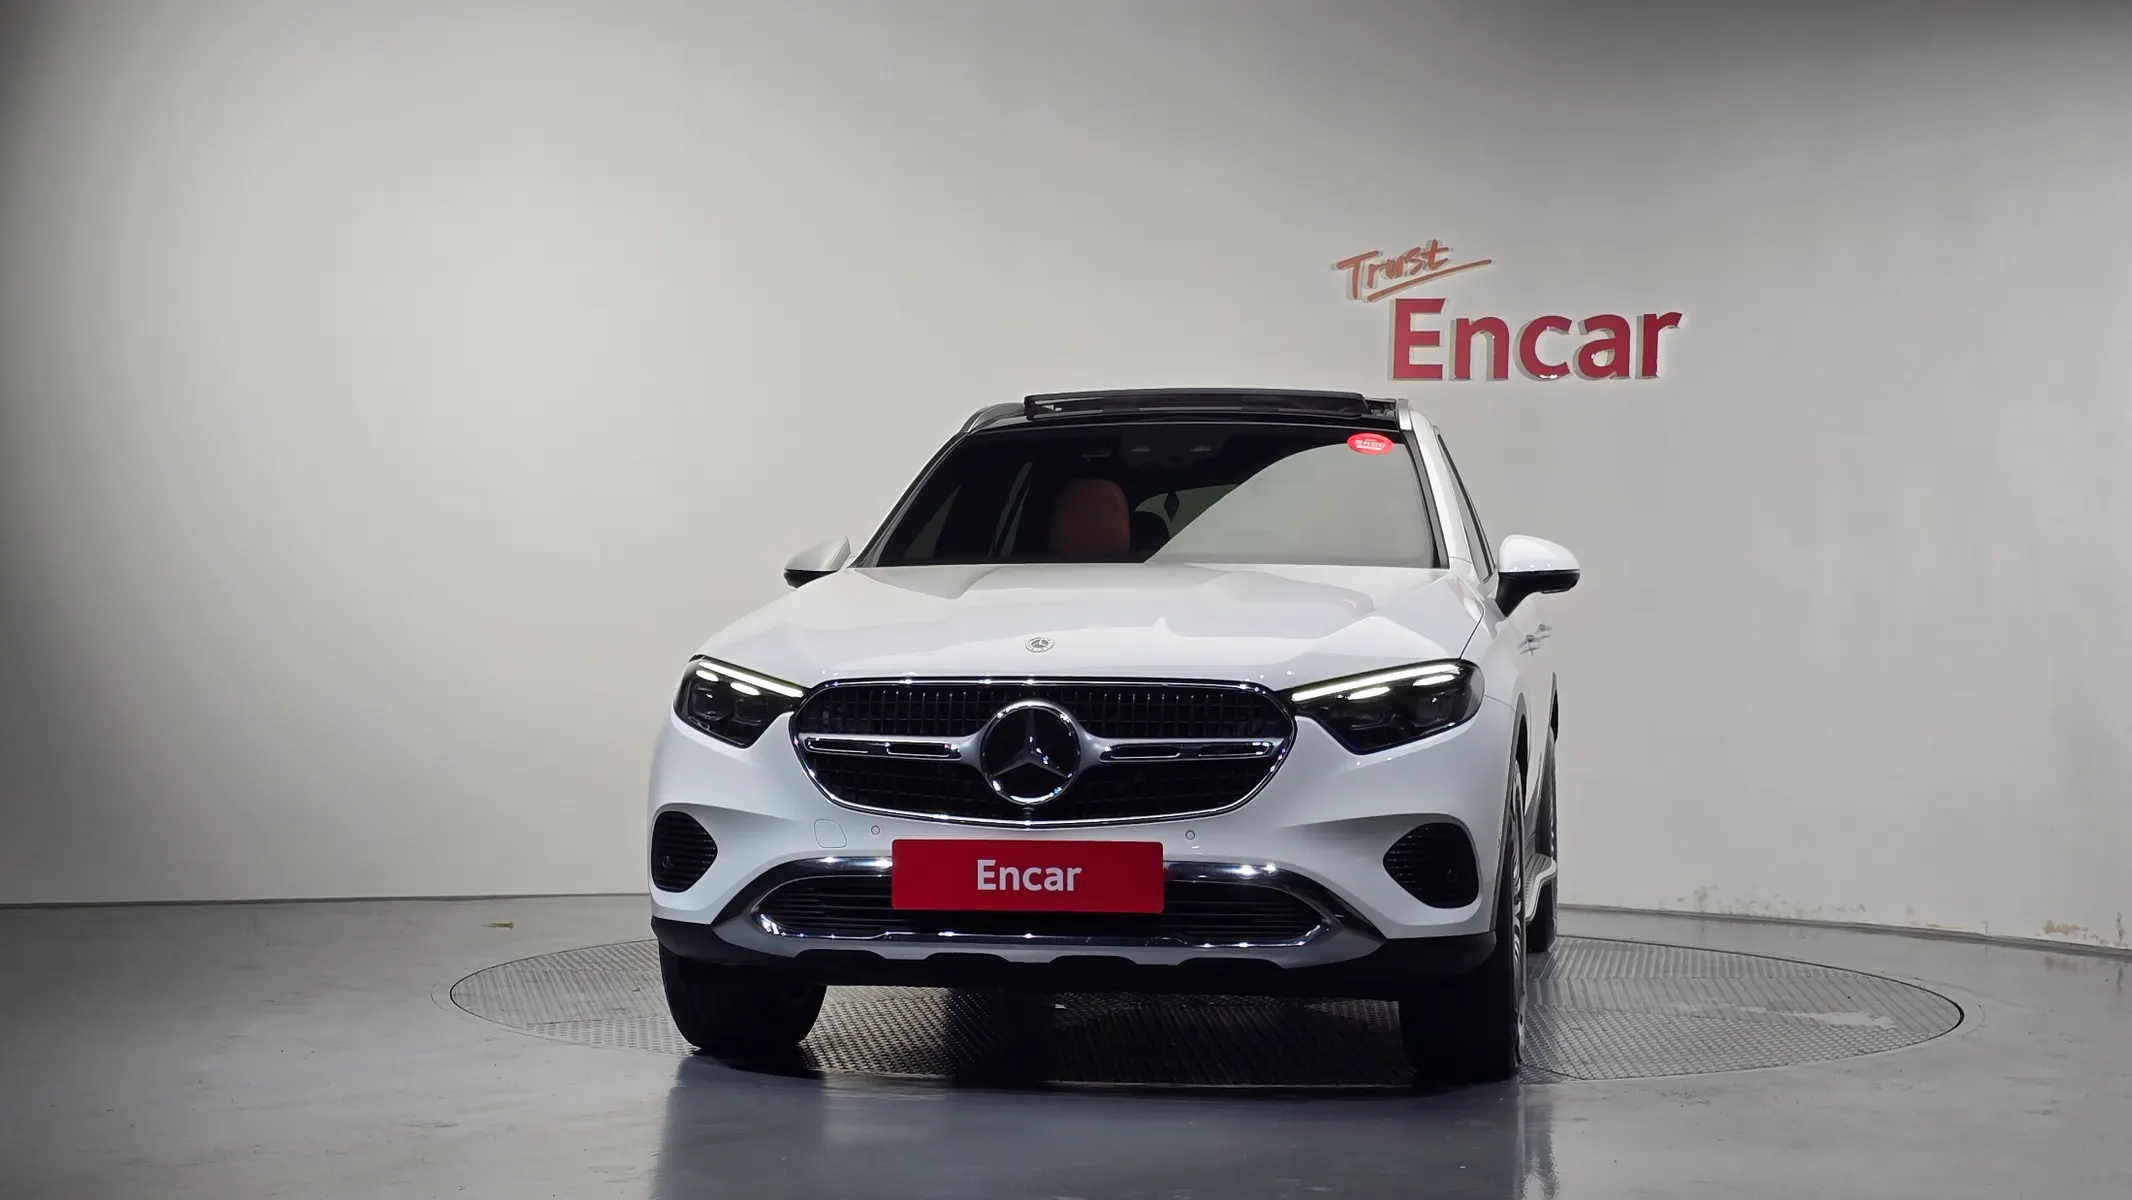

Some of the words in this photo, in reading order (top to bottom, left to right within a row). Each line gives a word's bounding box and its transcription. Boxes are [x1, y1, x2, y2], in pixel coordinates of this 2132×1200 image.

[1335, 239, 1450, 299] Trust
[1392, 297, 1683, 380] Encar
[976, 858, 1083, 892] Encar
